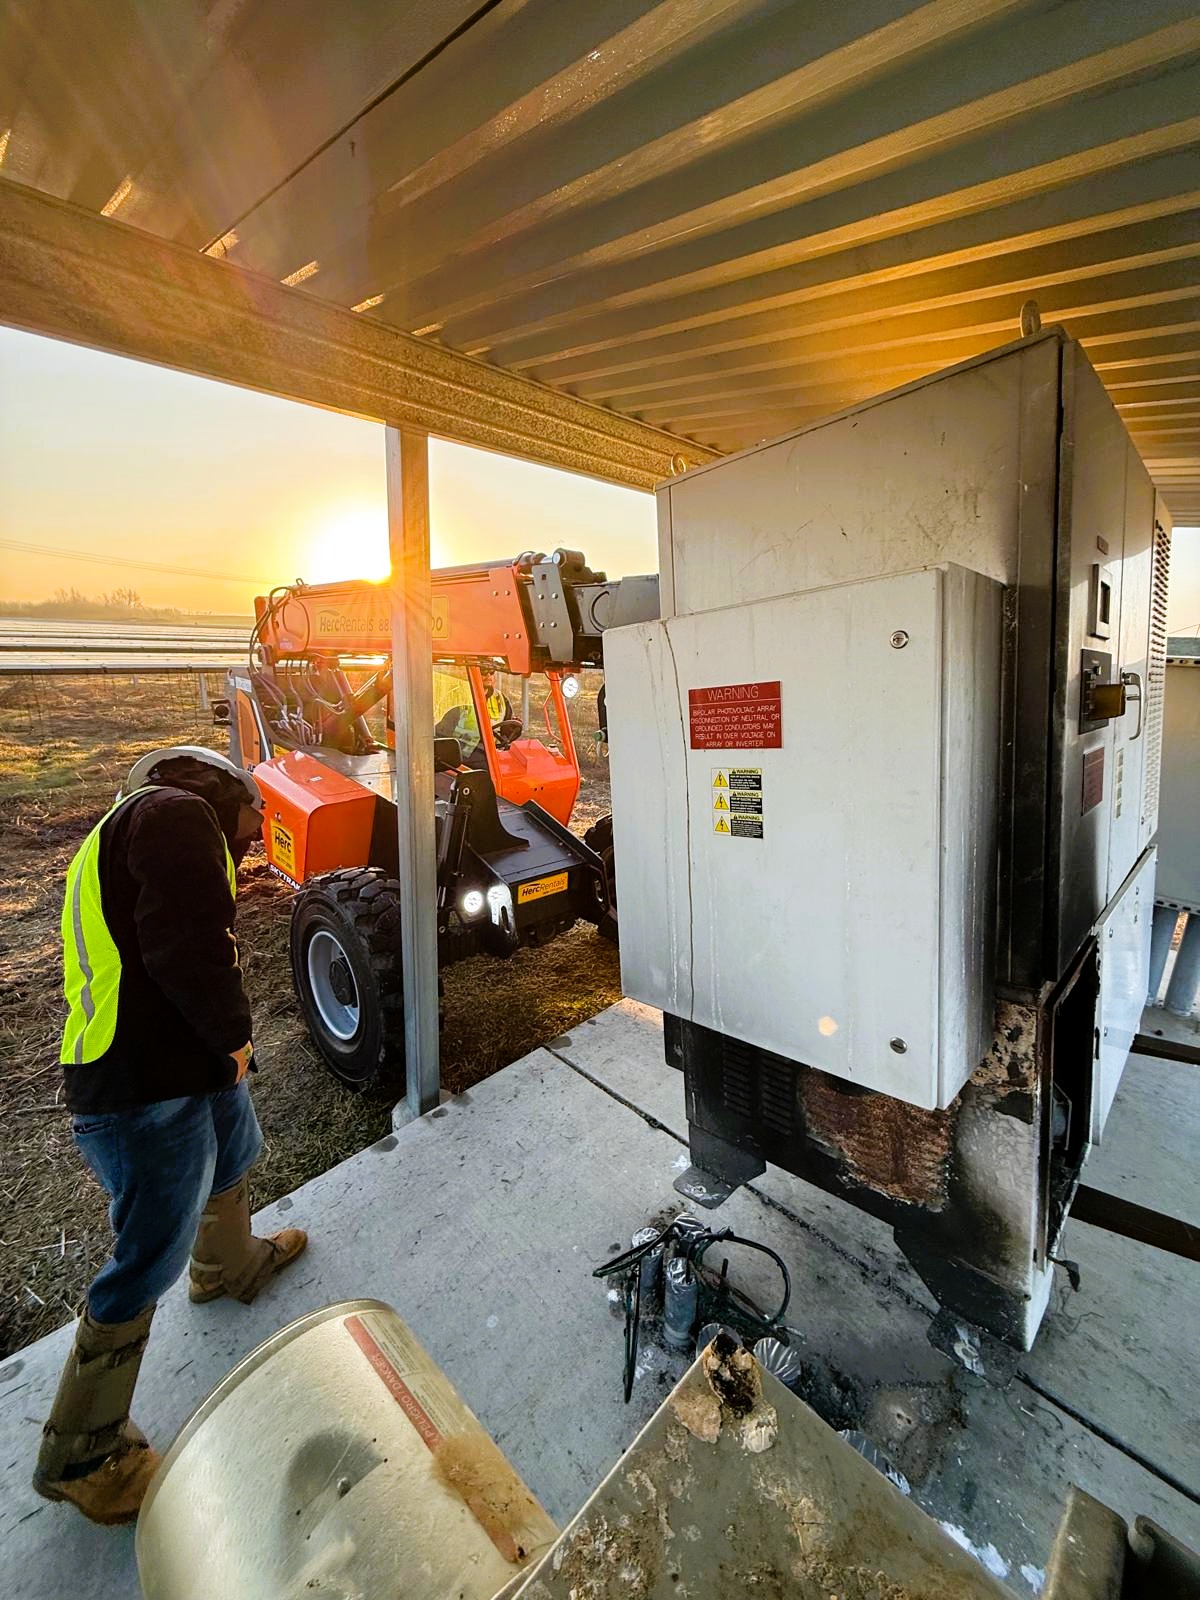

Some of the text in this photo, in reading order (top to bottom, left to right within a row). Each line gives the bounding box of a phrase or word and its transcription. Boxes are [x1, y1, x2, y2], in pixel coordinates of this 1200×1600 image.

[707, 686, 759, 700] WARNING
[691, 716, 729, 724] DISCONNECTION
[695, 724, 723, 732] GROUNDED
[741, 731, 765, 739] VOLTAGE
[274, 831, 292, 854] Herc
[522, 878, 565, 896] HercRentals
[373, 1352, 402, 1391] DANGER
[401, 1395, 436, 1438] PELIGRO
